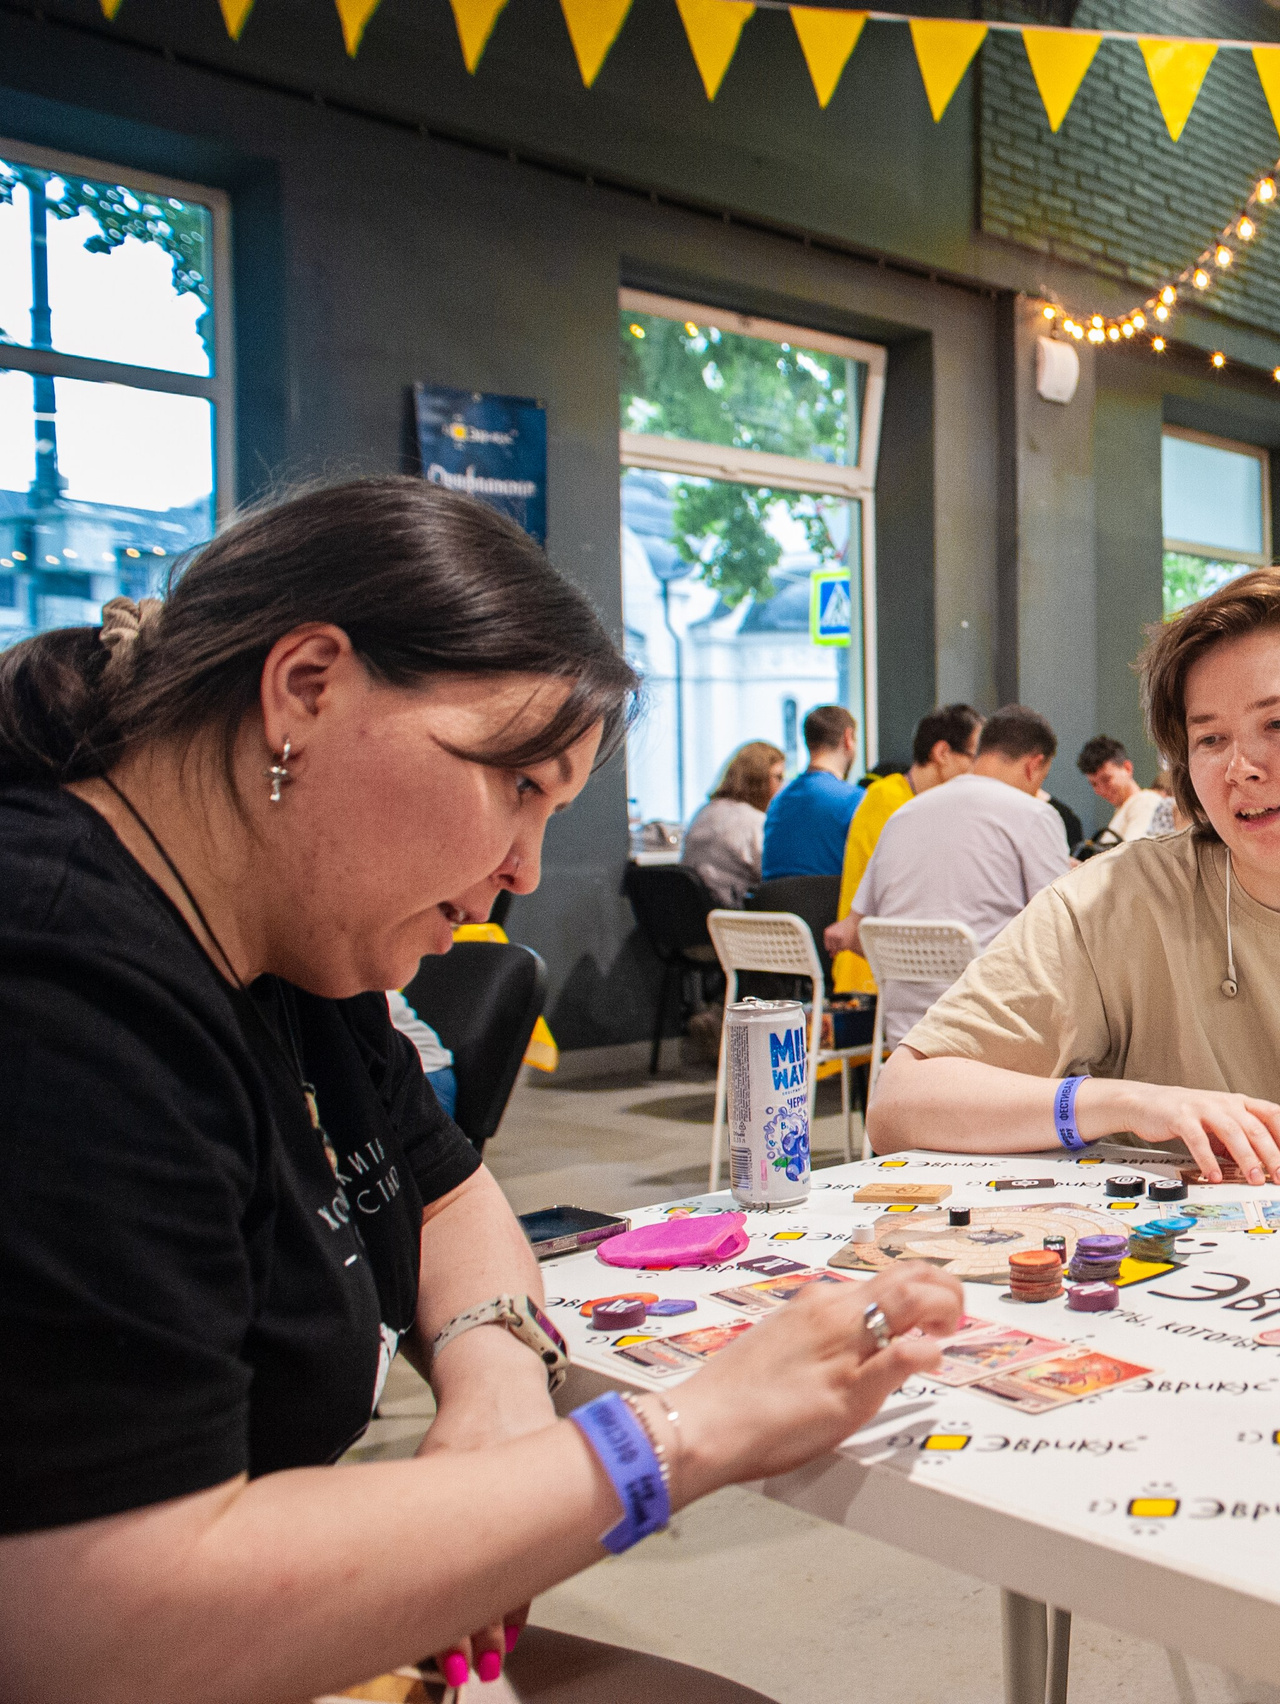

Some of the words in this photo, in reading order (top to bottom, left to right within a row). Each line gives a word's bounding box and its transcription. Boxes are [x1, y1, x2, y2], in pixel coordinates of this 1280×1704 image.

[769, 1026, 805, 1068] MIL
[772, 1062, 804, 1091] WAV
[909, 1160, 1002, 1169] Эврикус
[1123, 1377, 1273, 1394] Эврикус
[976, 1435, 1140, 1456] Эврикус
